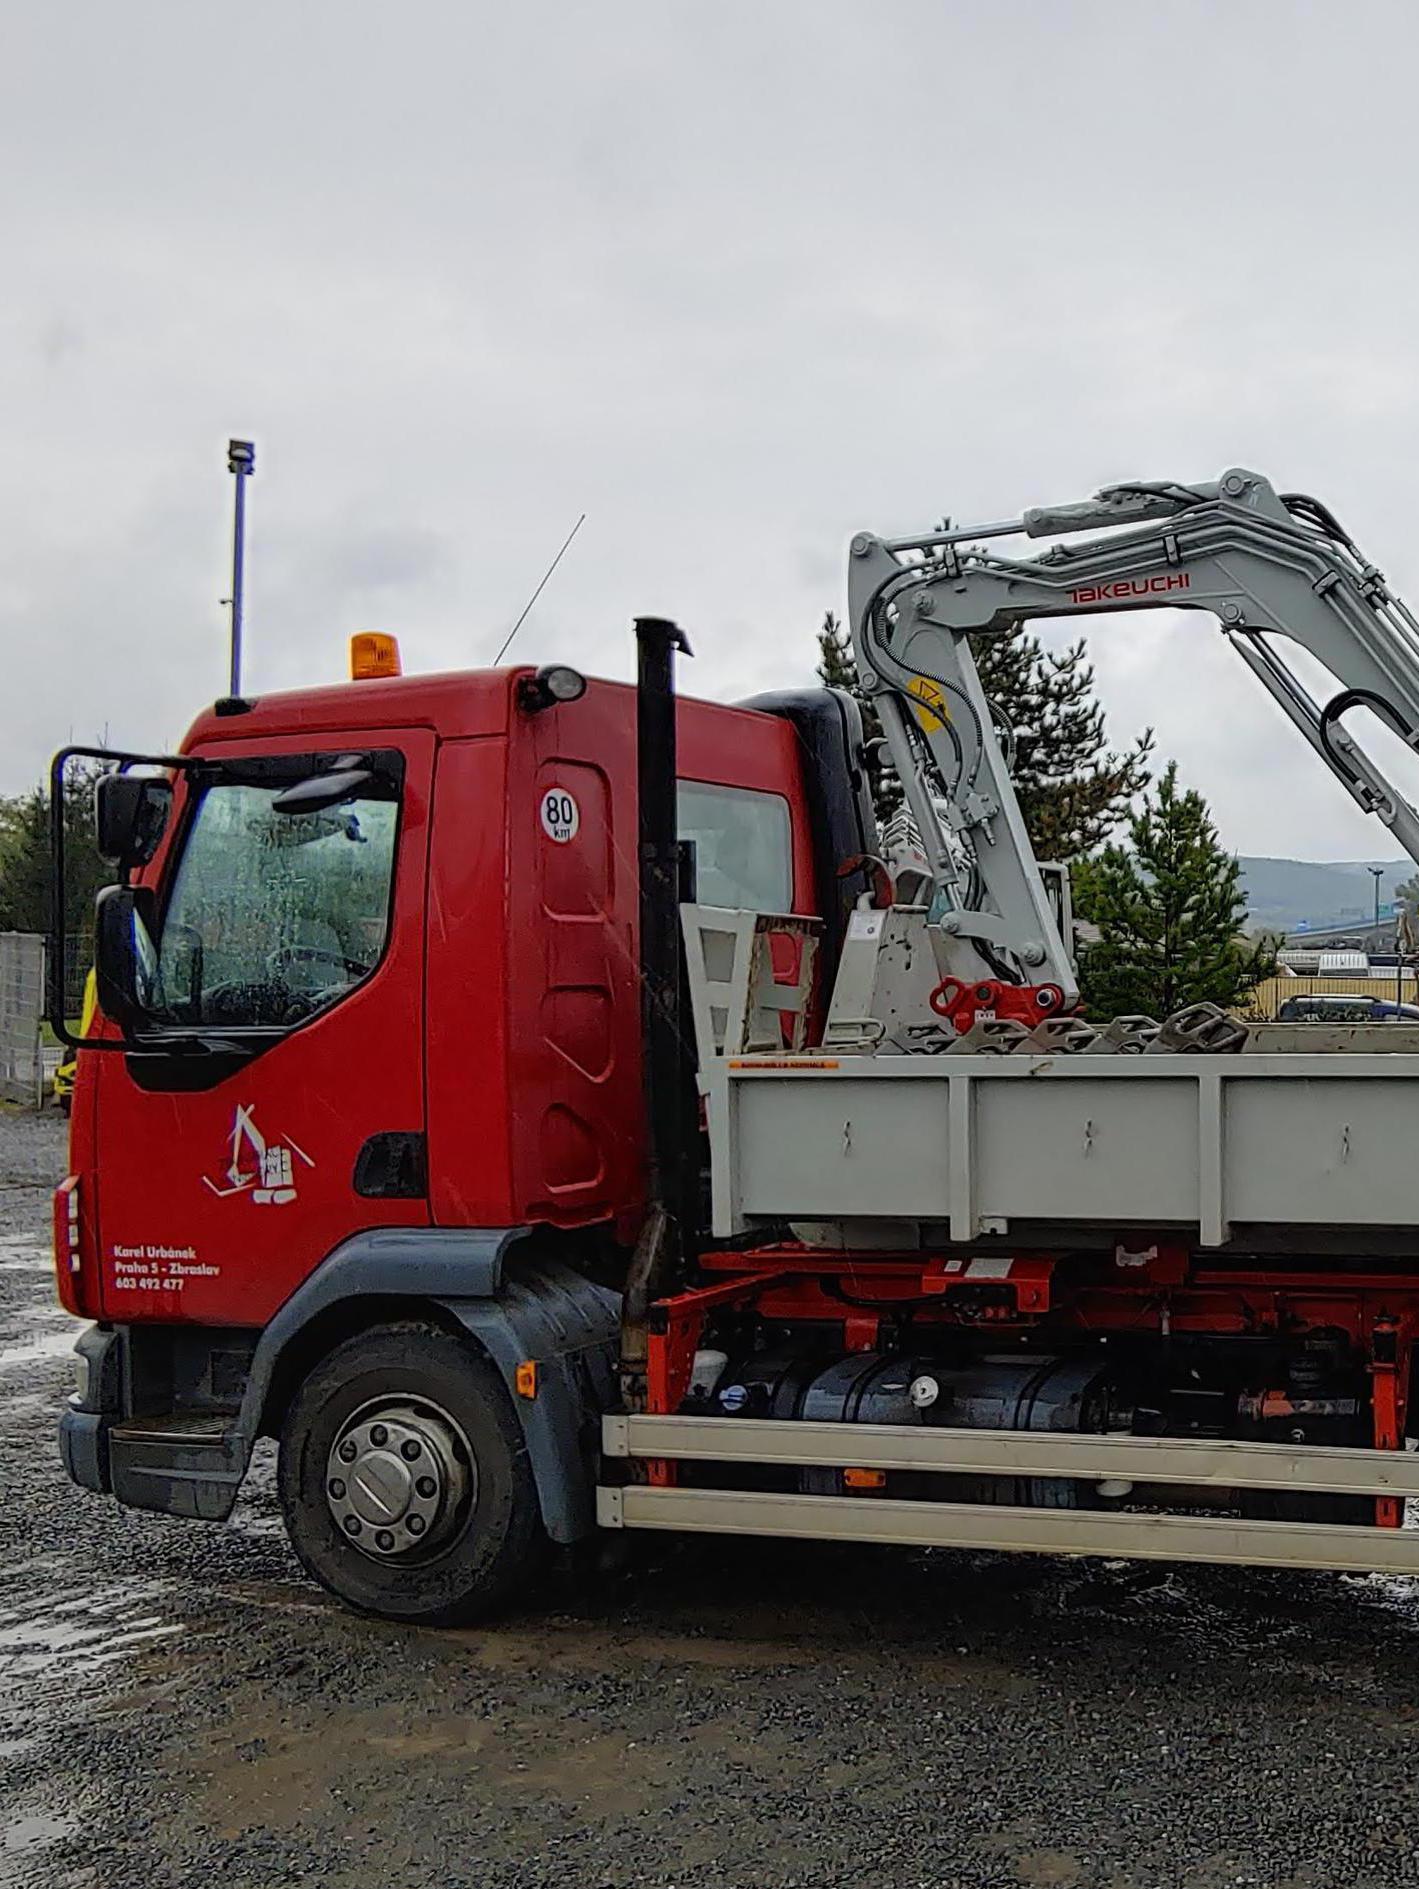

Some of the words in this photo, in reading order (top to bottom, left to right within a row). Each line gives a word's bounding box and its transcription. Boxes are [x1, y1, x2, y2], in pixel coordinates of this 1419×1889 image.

[1065, 573, 1190, 604] TAKEUCHI
[546, 796, 573, 825] 80
[553, 825, 570, 840] km
[113, 1244, 145, 1258] Karel
[146, 1245, 197, 1260] Urbánek
[115, 1261, 149, 1274] Praha
[150, 1262, 159, 1275] 5
[168, 1262, 220, 1276] Zbraslav
[116, 1277, 137, 1289] 603
[139, 1278, 160, 1290] 492
[162, 1279, 184, 1291] 477
